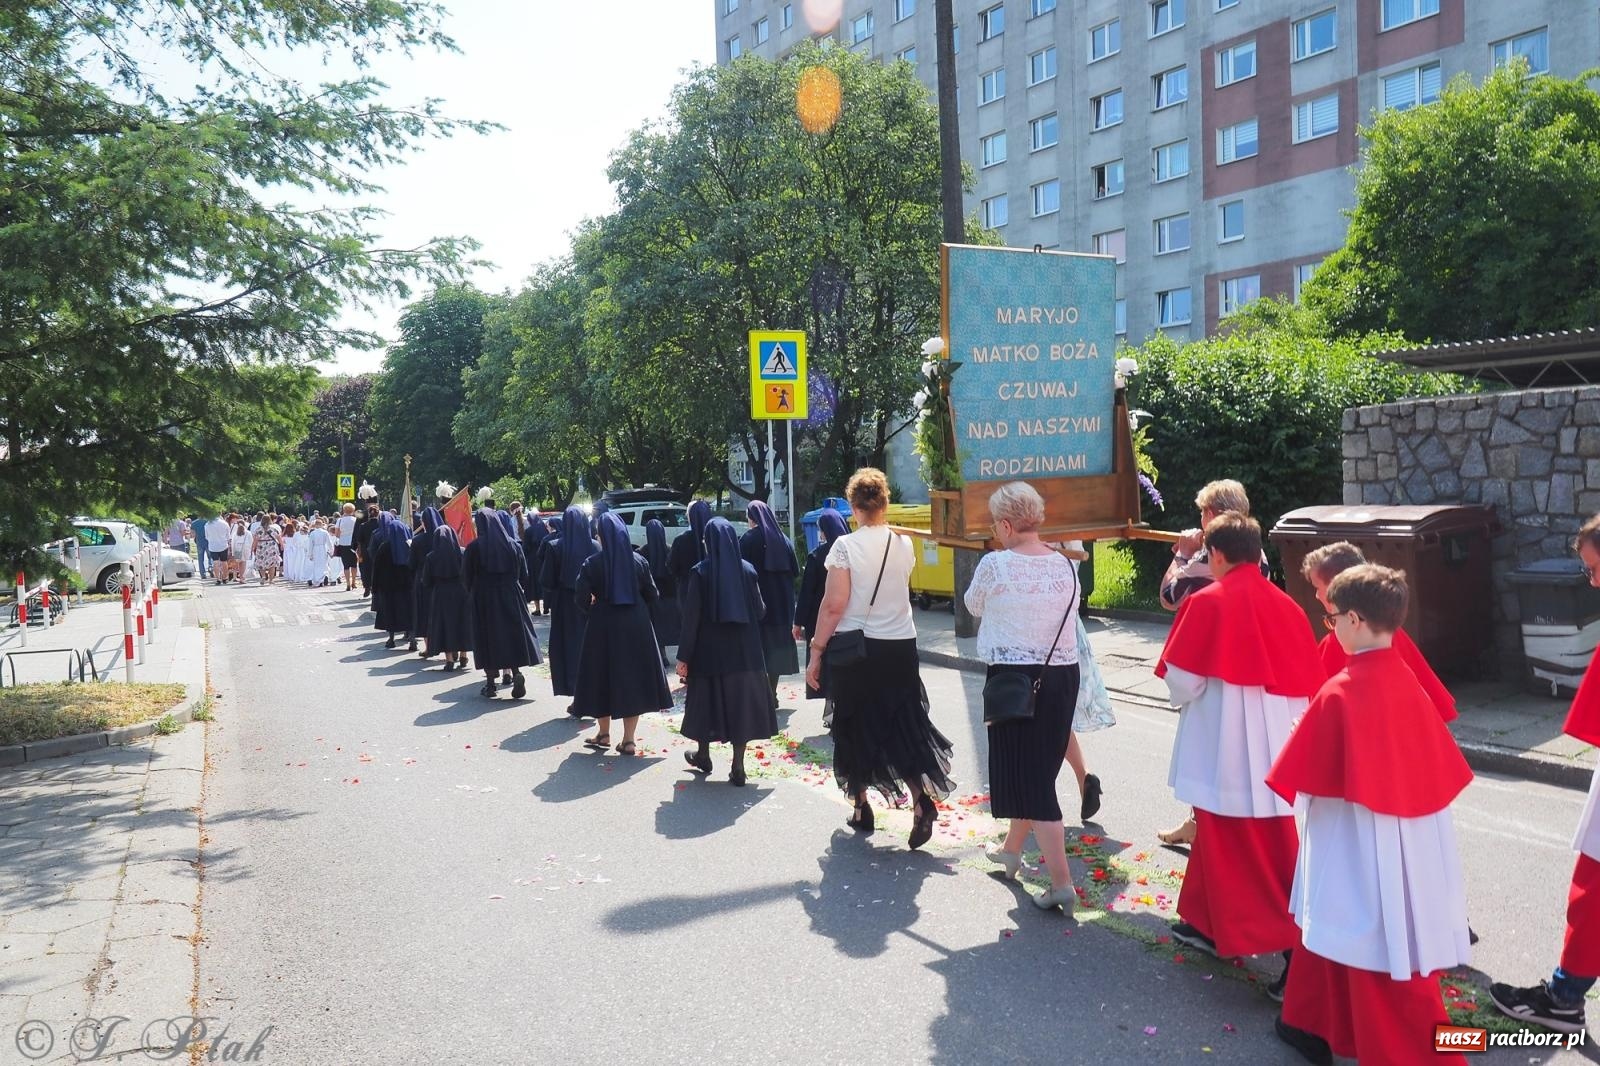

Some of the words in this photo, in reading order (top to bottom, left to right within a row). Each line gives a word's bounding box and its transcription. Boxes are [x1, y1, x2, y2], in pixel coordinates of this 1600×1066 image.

[997, 308, 1078, 324] MARYJO
[973, 345, 1039, 363] MATKO
[1050, 339, 1098, 360] BOŻA
[999, 383, 1077, 400] CZUWAJ
[968, 422, 1008, 439] NAD
[1018, 417, 1100, 436] NASZYMI
[981, 455, 1086, 476] RODZINAMI
